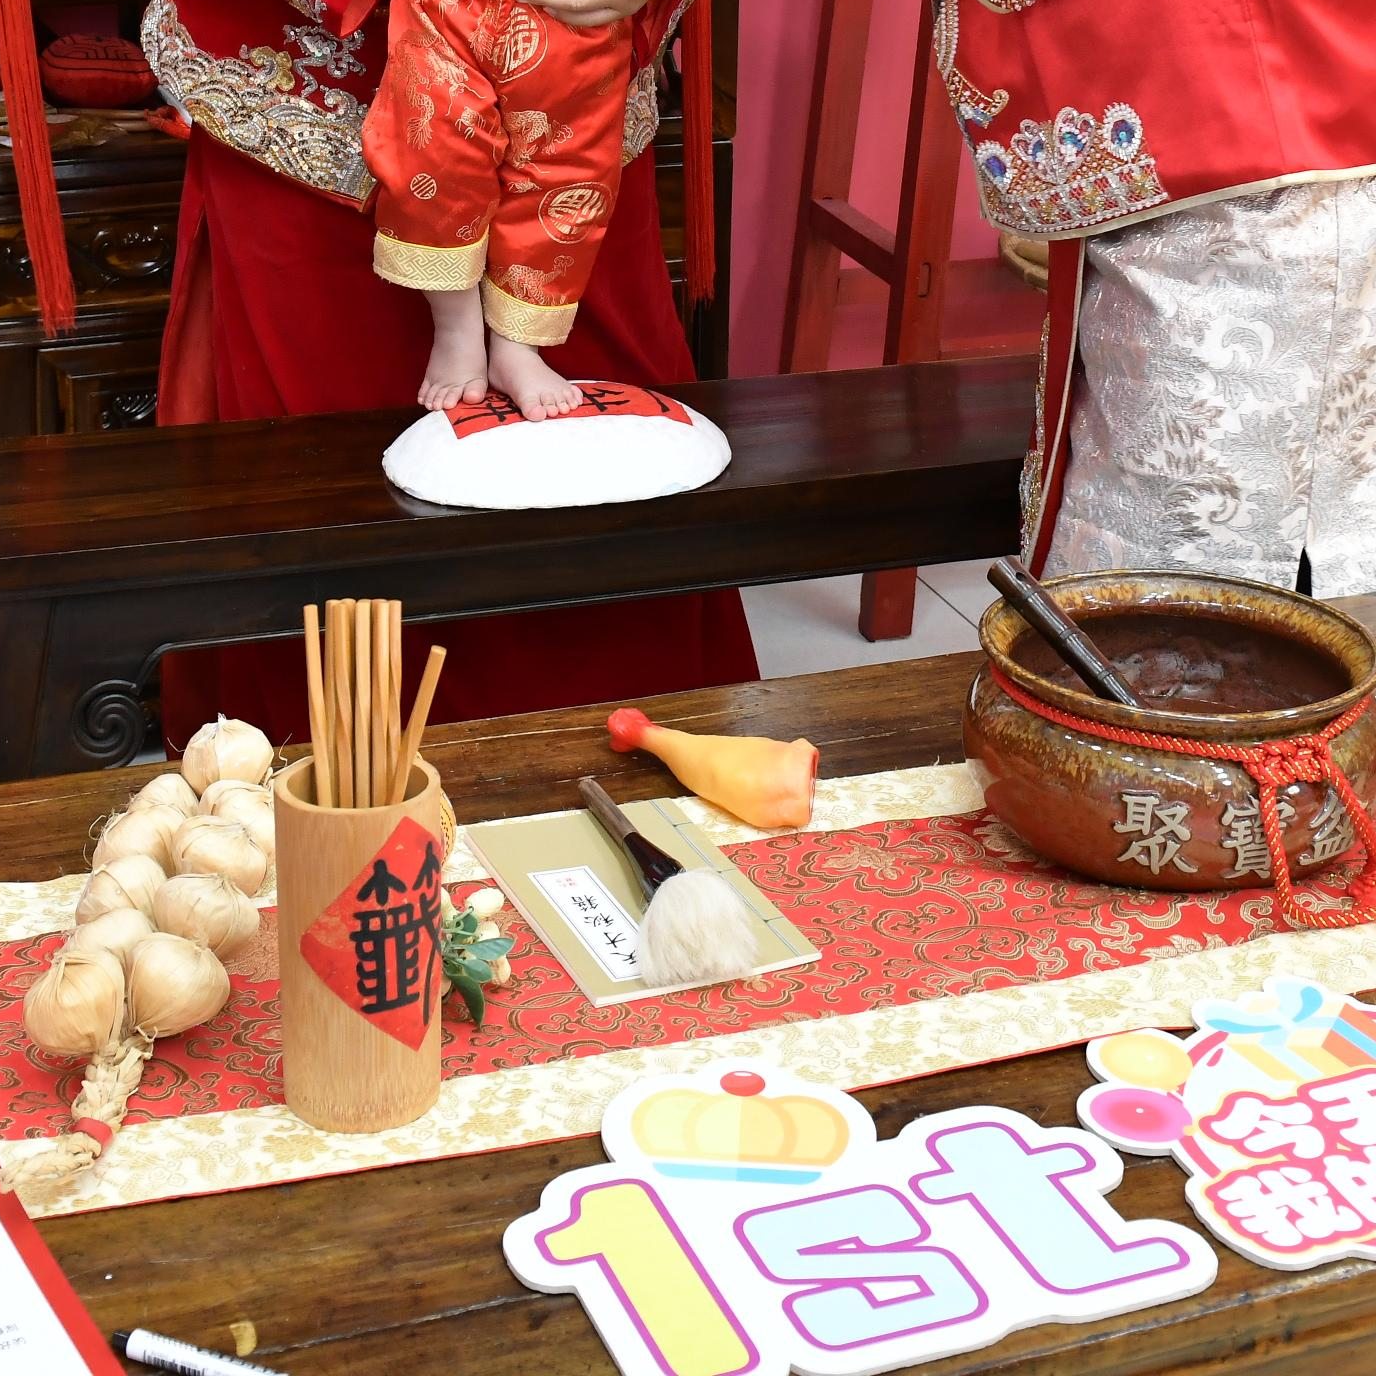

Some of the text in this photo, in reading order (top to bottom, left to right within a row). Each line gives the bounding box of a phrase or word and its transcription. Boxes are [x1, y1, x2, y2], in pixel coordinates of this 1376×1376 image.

[1113, 792, 1356, 880] 聚寶盆
[533, 1121, 1191, 1376] 1st
